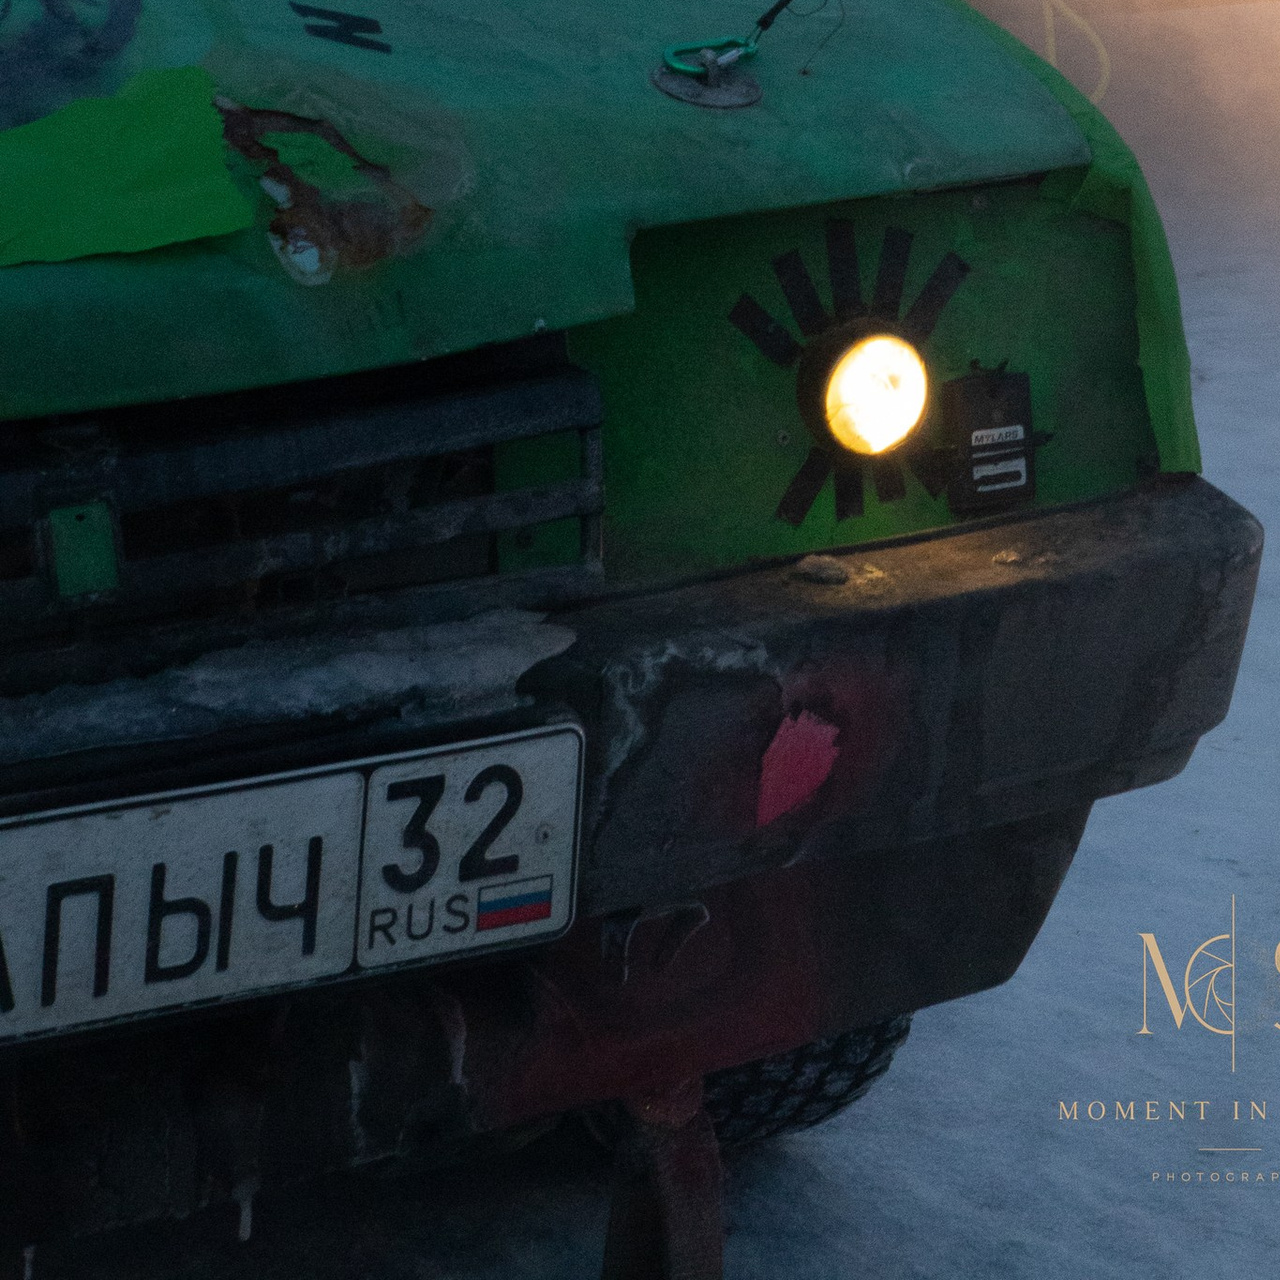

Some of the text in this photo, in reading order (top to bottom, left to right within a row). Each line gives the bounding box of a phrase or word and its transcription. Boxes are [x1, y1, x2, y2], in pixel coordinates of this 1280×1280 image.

[381, 764, 524, 893] 32
[0, 836, 323, 1014] ПЫЧ
[368, 894, 471, 950] RUS
